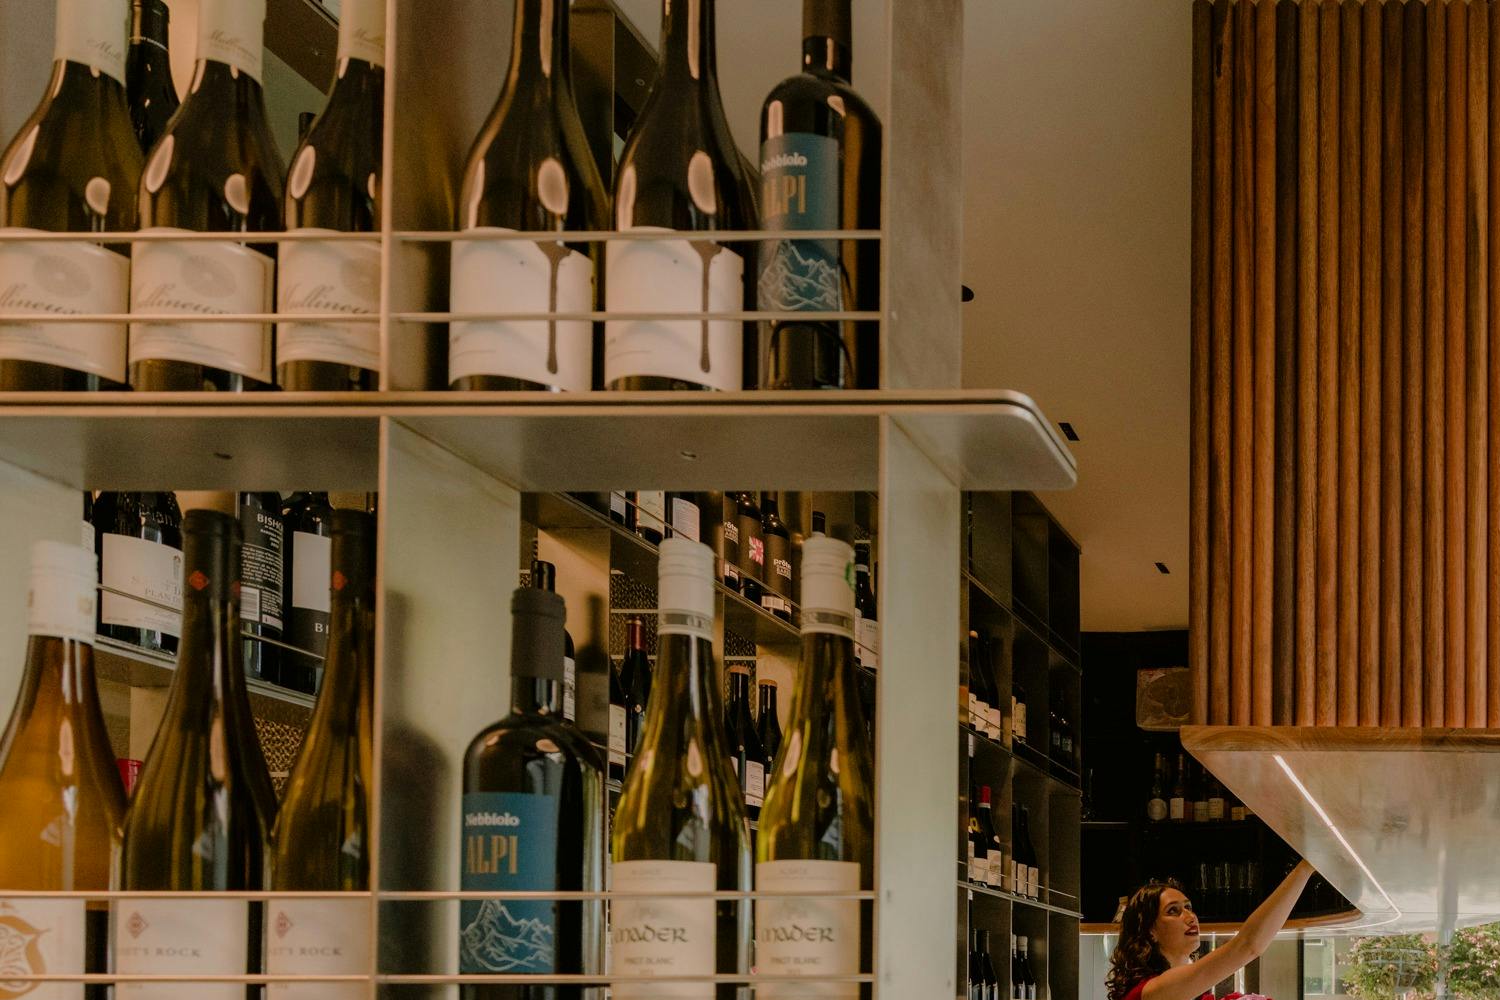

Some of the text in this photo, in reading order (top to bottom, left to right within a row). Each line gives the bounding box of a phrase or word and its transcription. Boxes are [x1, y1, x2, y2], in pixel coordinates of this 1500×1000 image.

[466, 834, 518, 875] ALPI
[155, 947, 202, 958] ROCK
[298, 947, 343, 957] ROCK
